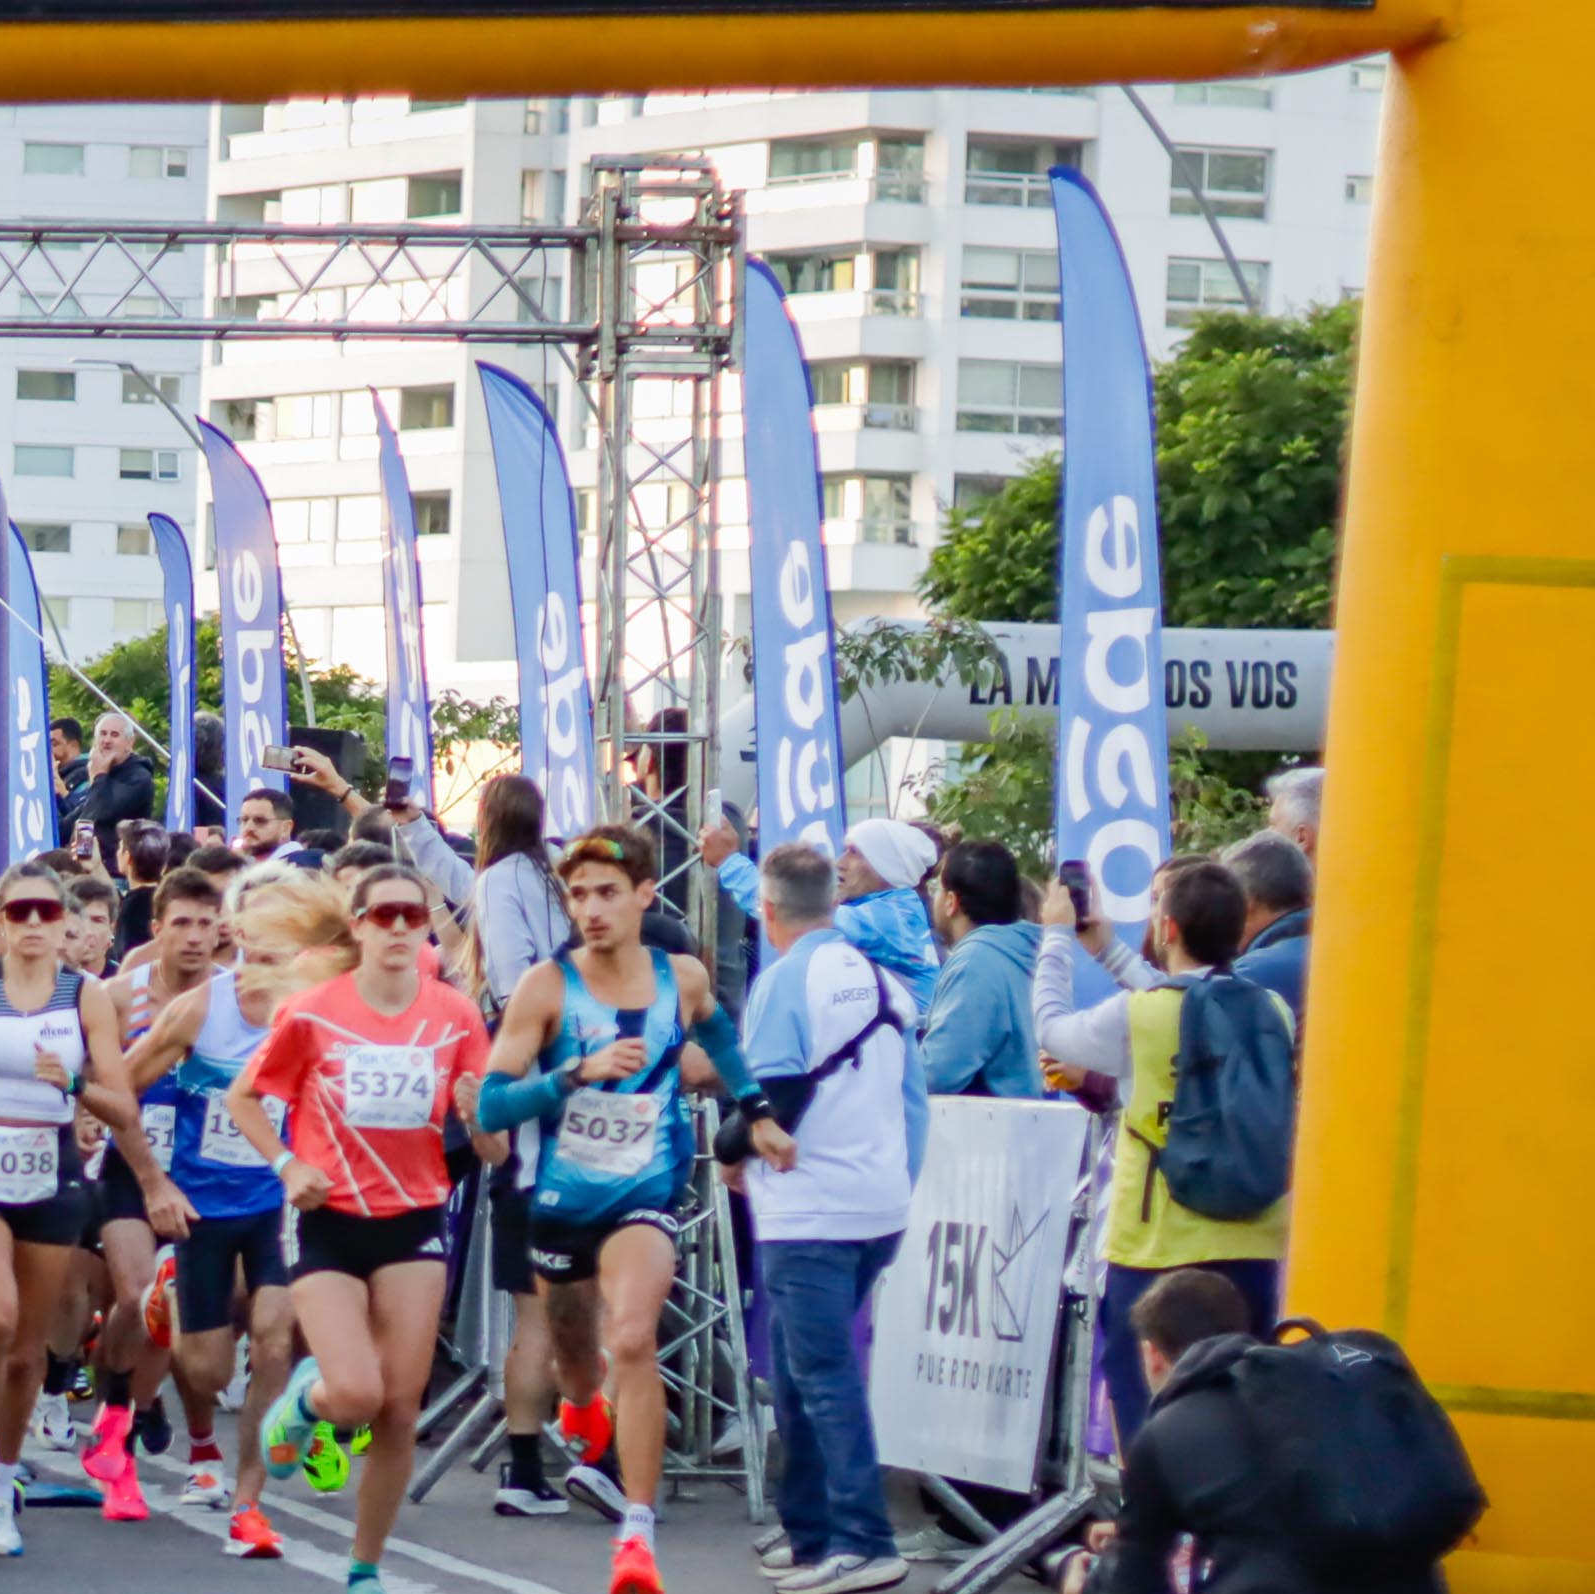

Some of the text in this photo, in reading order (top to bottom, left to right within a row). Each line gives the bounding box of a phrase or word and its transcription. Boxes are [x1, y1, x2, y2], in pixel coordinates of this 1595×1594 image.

[1165, 660, 1211, 708] OS
[1226, 660, 1298, 709] VOS
[350, 1071, 431, 1099] 5374
[567, 1111, 653, 1144] 5037
[925, 1220, 988, 1338] 15K
[916, 1353, 1032, 1399] PUERTO NORTE
